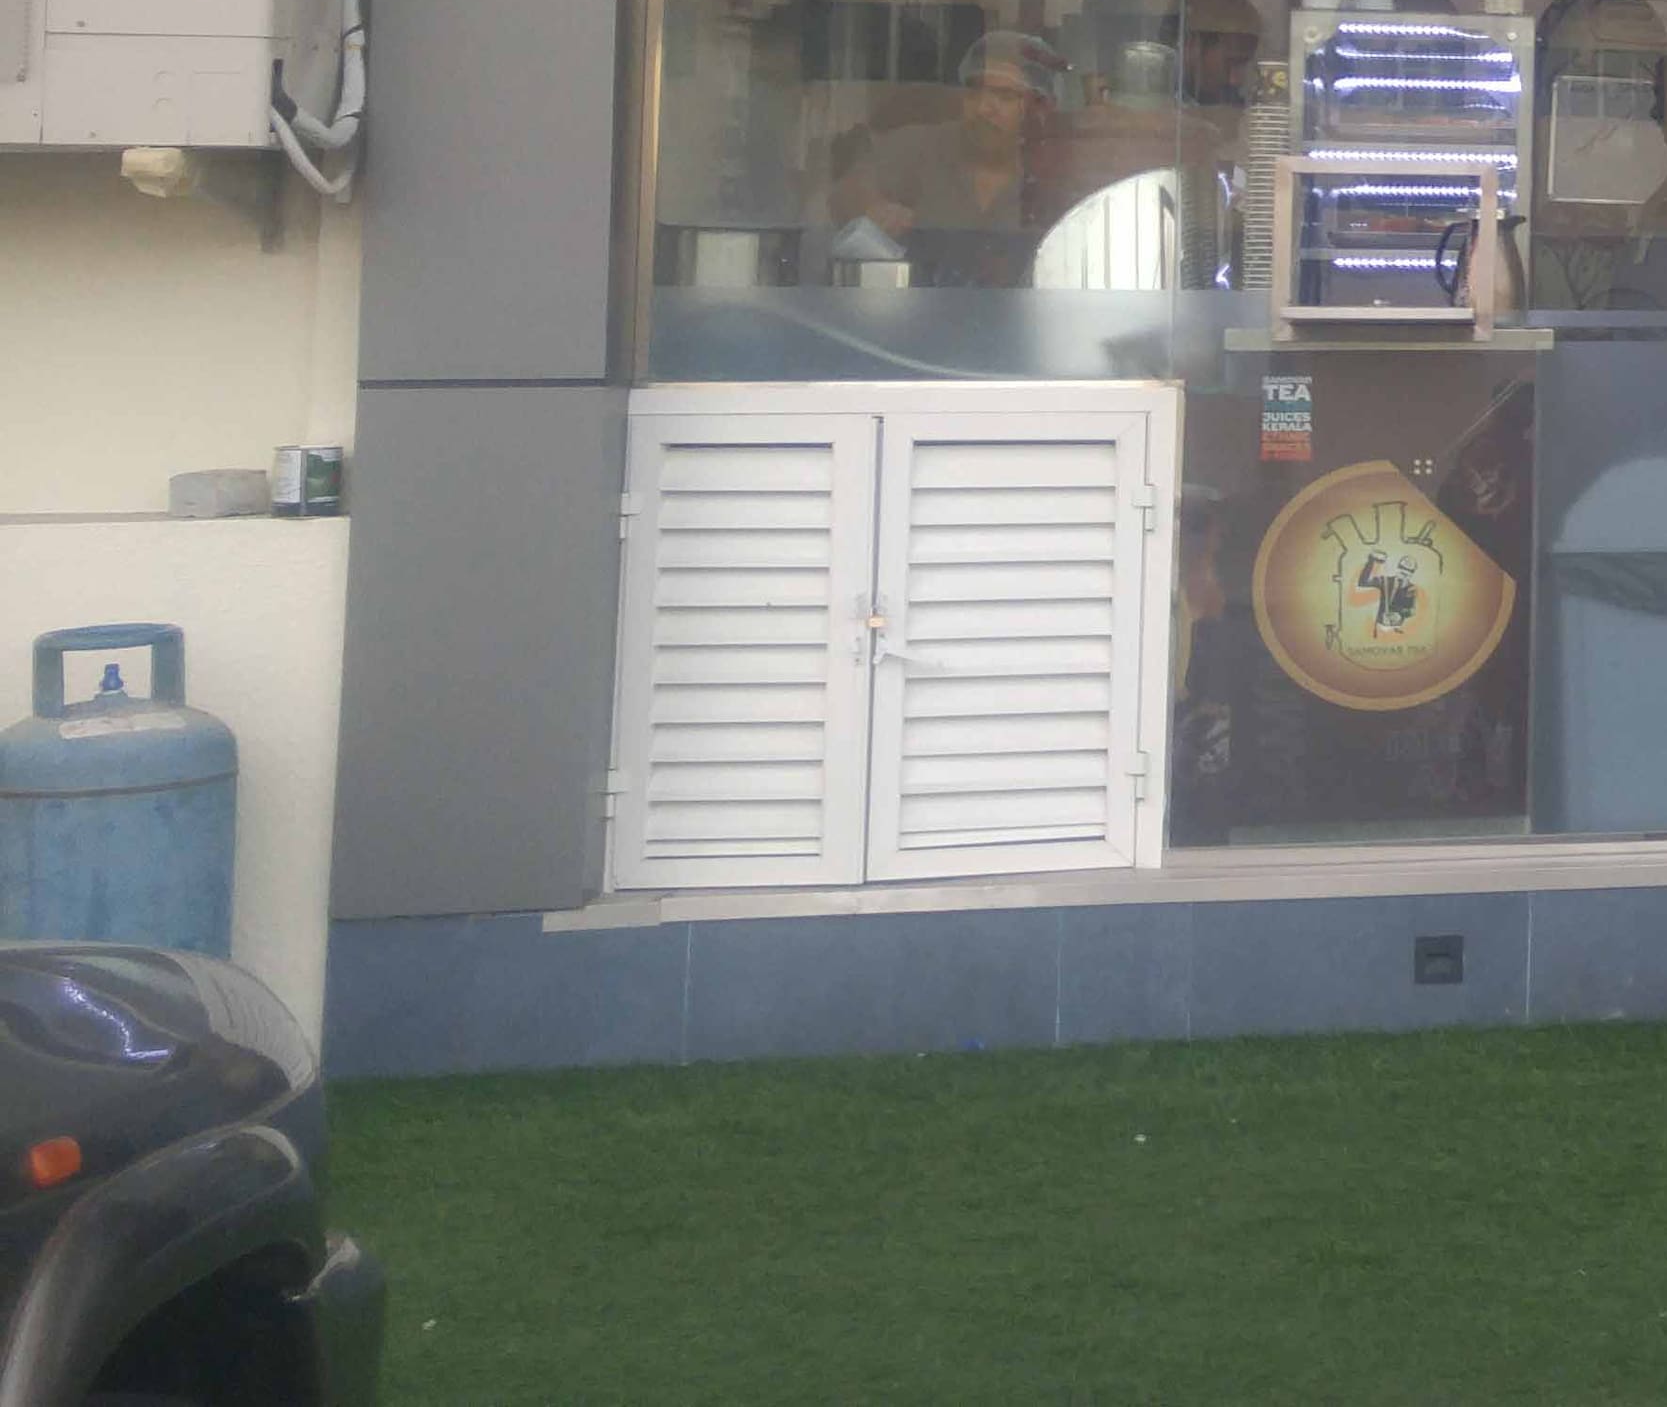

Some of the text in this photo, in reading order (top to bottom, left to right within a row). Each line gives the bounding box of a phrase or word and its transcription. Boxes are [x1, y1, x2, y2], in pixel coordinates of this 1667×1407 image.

[1262, 384, 1312, 402] TEA
[1263, 412, 1312, 422] JUICES
[1263, 422, 1313, 432] KERALA
